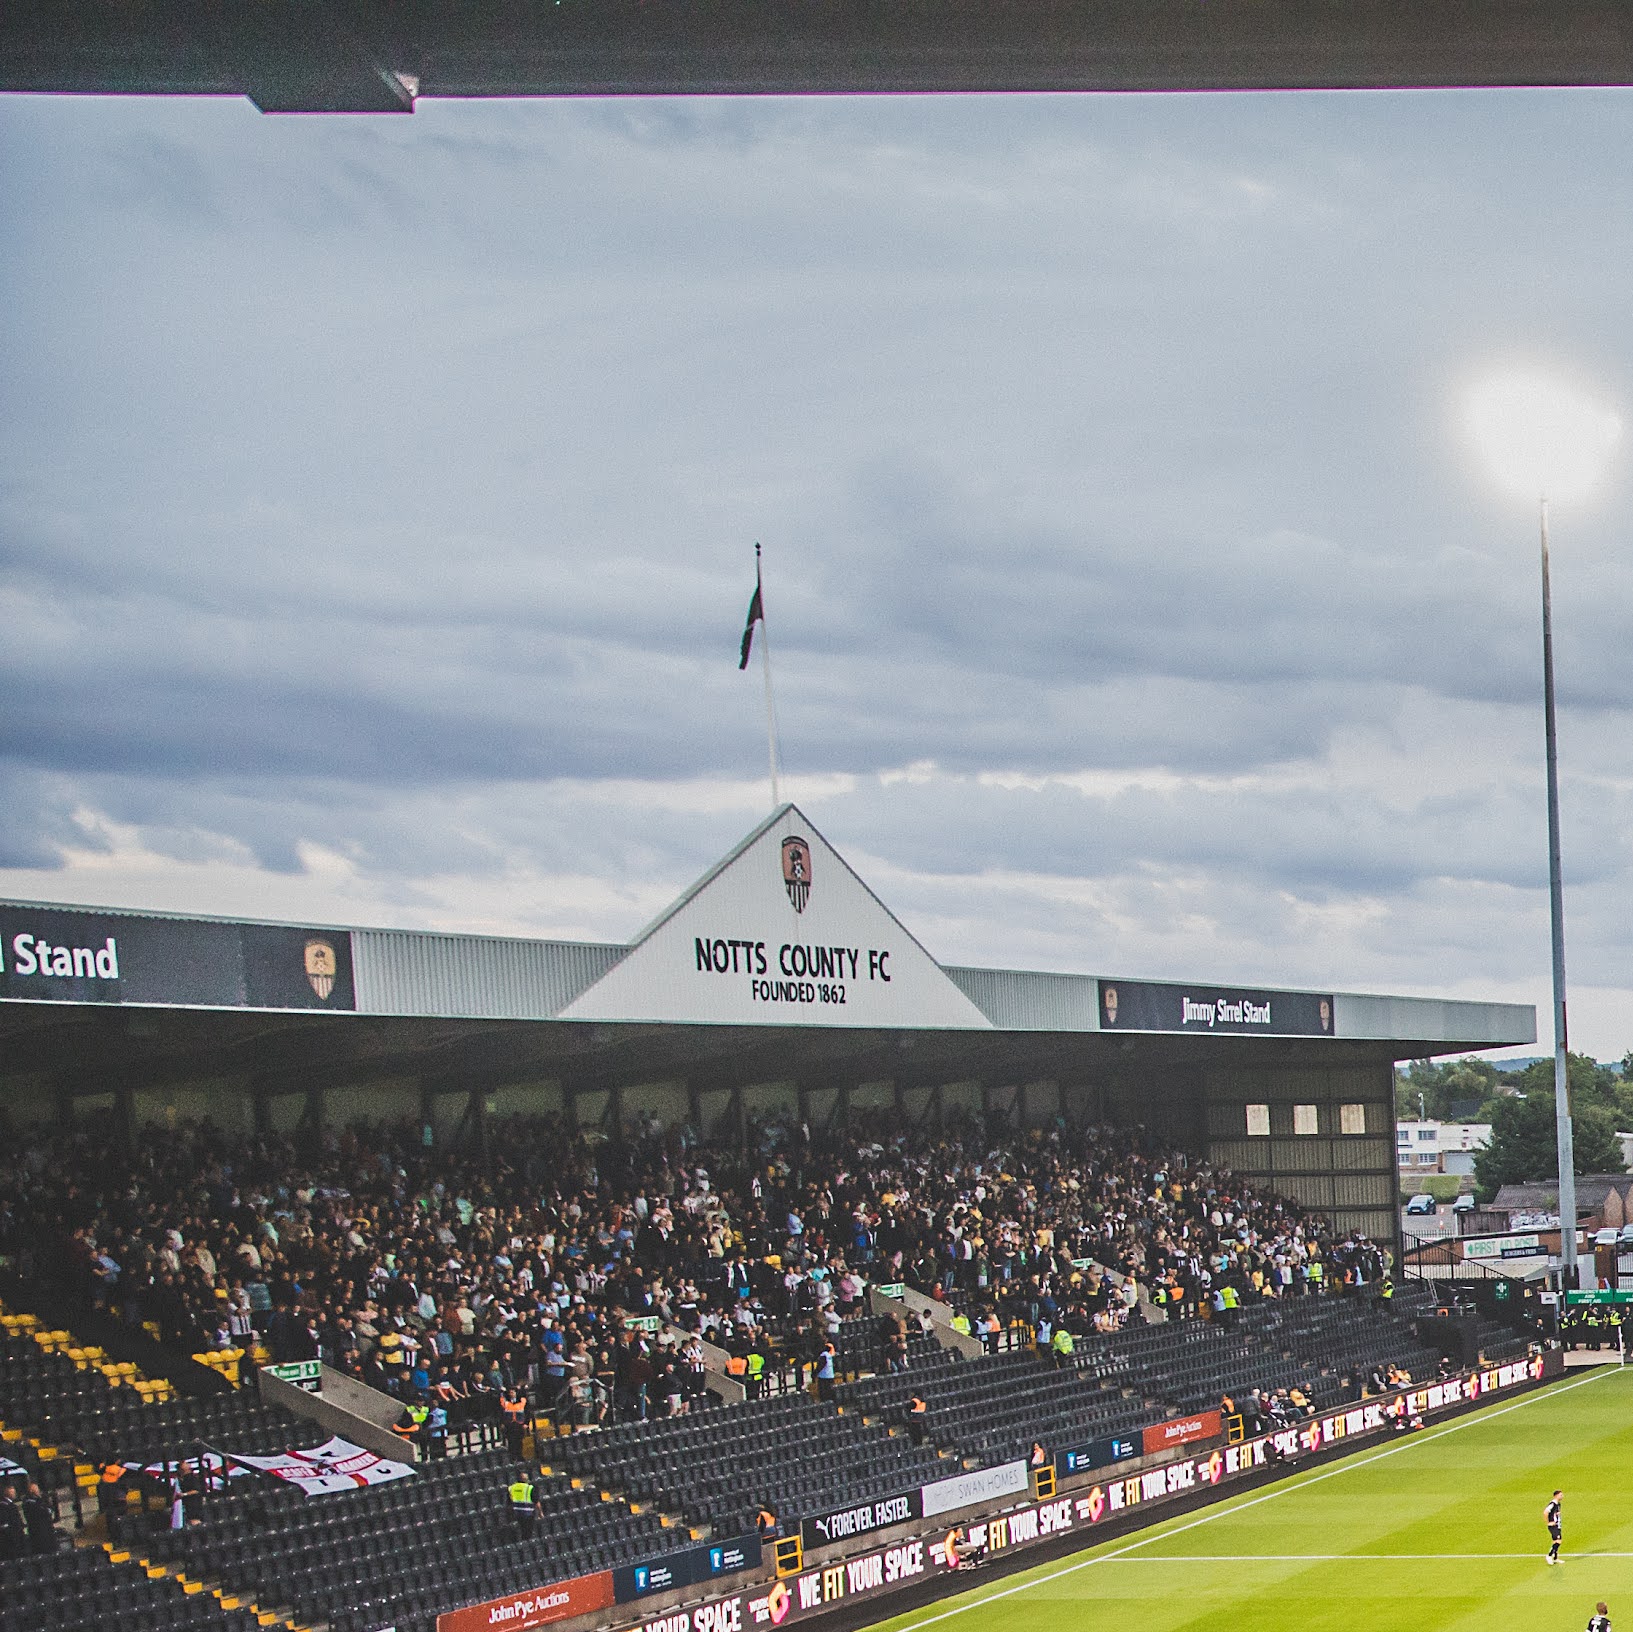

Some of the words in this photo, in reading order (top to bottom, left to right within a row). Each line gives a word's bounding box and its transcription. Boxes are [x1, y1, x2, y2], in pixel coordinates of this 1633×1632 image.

[13, 933, 120, 979] Stand
[695, 937, 767, 975] NOTTS
[779, 943, 858, 979] COUNTY
[869, 950, 891, 982] FC
[752, 979, 814, 1003] FOUNDED
[817, 983, 846, 1004] 1862
[1182, 996, 1216, 1028] Jimmy
[1217, 999, 1243, 1023] Sirrel
[1244, 1000, 1270, 1024] Stand
[1475, 1240, 1496, 1255] FIRST
[1514, 1236, 1535, 1248] POST
[1239, 1438, 1253, 1468] FIT
[958, 1478, 985, 1500] SWAN
[988, 1470, 1018, 1494] HOMES
[1108, 1482, 1126, 1510] WE
[1126, 1476, 1141, 1506] FIT
[1141, 1469, 1168, 1500] YOUR
[1166, 1460, 1195, 1492] SPACE
[830, 1501, 876, 1539] FOREVER.
[876, 1496, 912, 1526] FASTER.
[988, 1518, 1008, 1550] FIT
[1008, 1510, 1038, 1545] YOUR
[1039, 1498, 1072, 1534] SPACE
[798, 1572, 822, 1610] WE
[824, 1564, 846, 1602] FIT
[846, 1554, 884, 1594] YOUR
[884, 1542, 924, 1583] SPACE
[488, 1604, 516, 1624] John
[516, 1600, 534, 1619] Pye
[534, 1592, 570, 1613] Auctions
